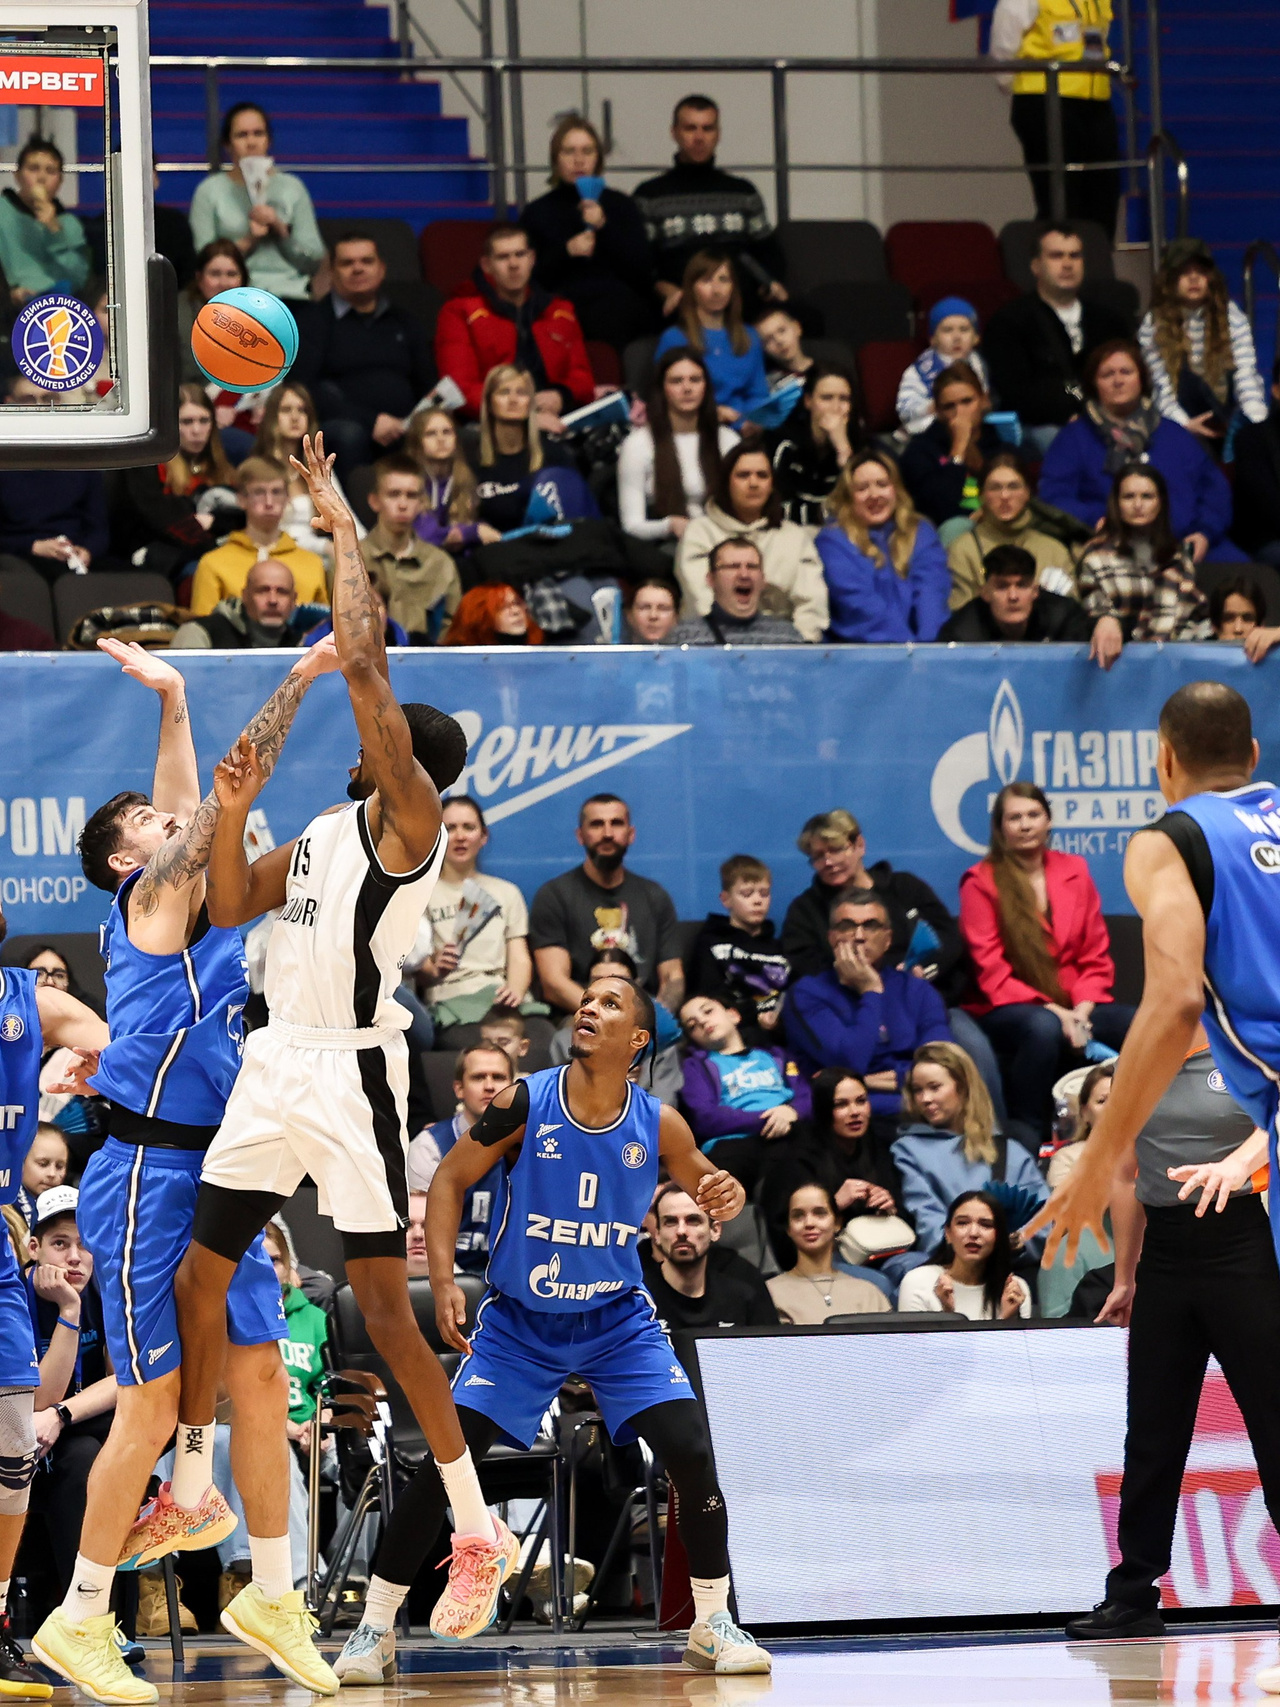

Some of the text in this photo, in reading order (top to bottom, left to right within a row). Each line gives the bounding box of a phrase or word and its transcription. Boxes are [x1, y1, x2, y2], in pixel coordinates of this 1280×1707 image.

[20, 297, 96, 327] ЕДИНАЯ ЛИГА ВТБ
[19, 358, 97, 389] VTB UNITED LEAGUE
[1048, 797, 1158, 820] РАНС
[536, 1151, 563, 1160] KELME
[578, 1171, 599, 1209] 0
[185, 1427, 203, 1455] PEAK
